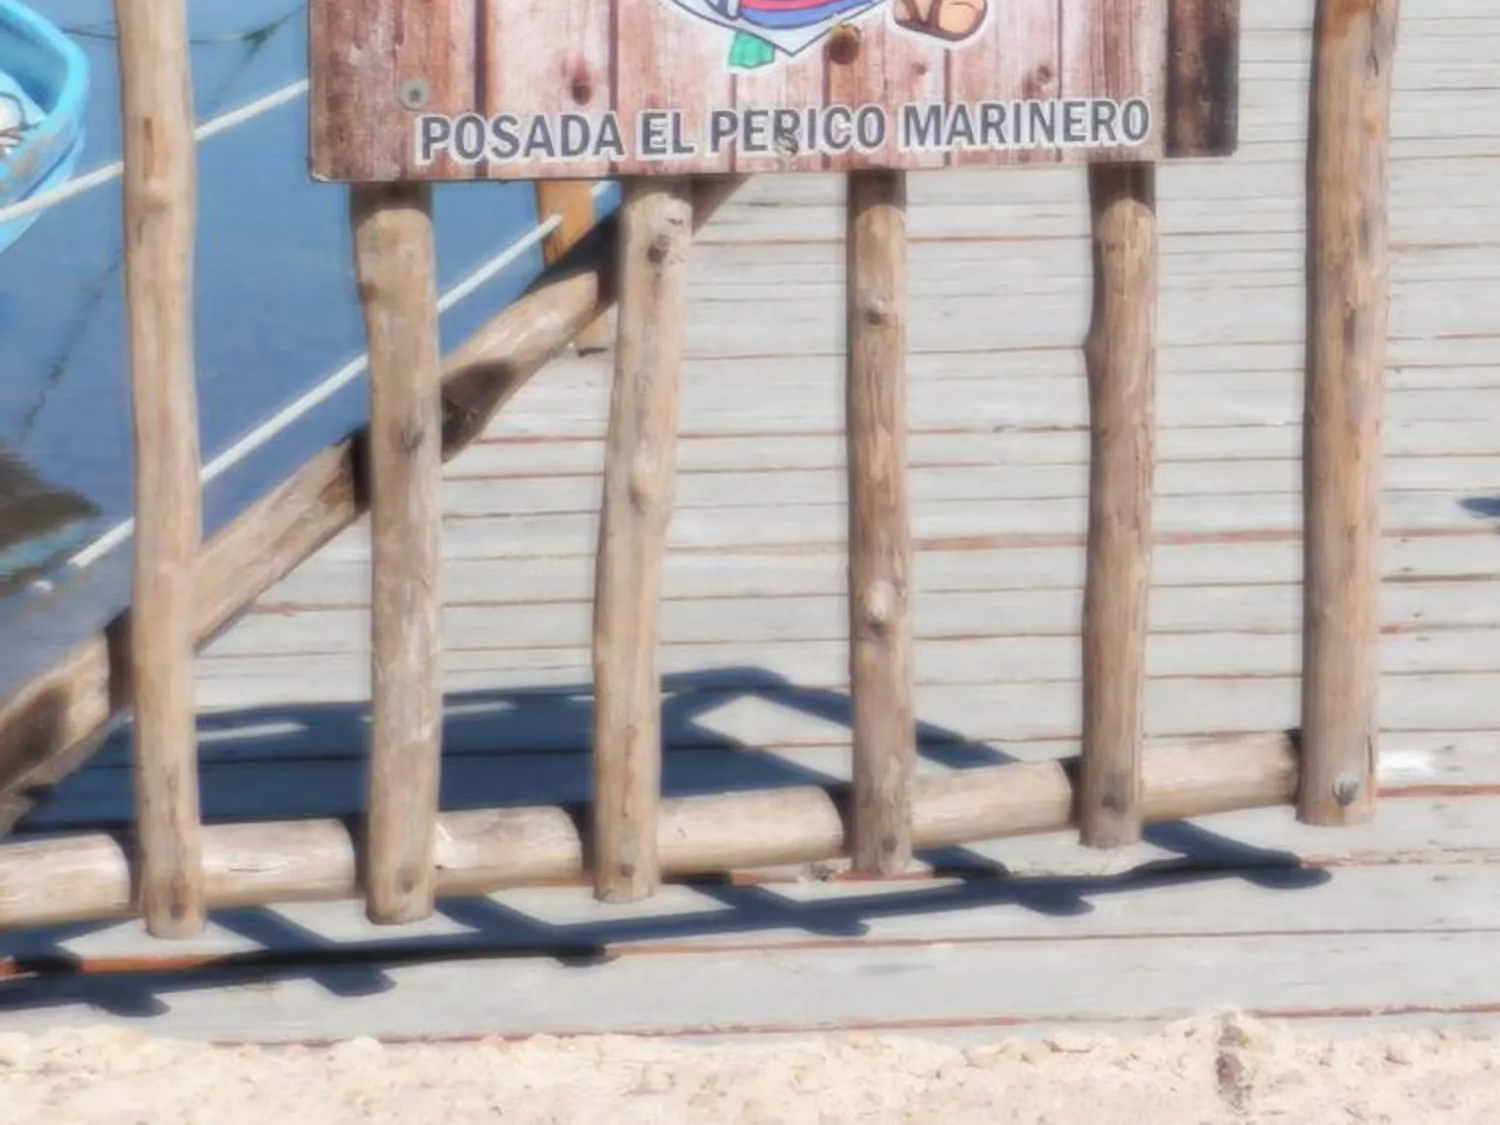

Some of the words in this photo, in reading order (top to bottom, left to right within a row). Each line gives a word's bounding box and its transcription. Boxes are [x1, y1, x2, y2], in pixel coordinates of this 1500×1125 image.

[419, 114, 625, 161] POSADA
[637, 110, 697, 157] EL
[708, 105, 887, 153] PERICO
[900, 98, 1152, 151] MARINERO
